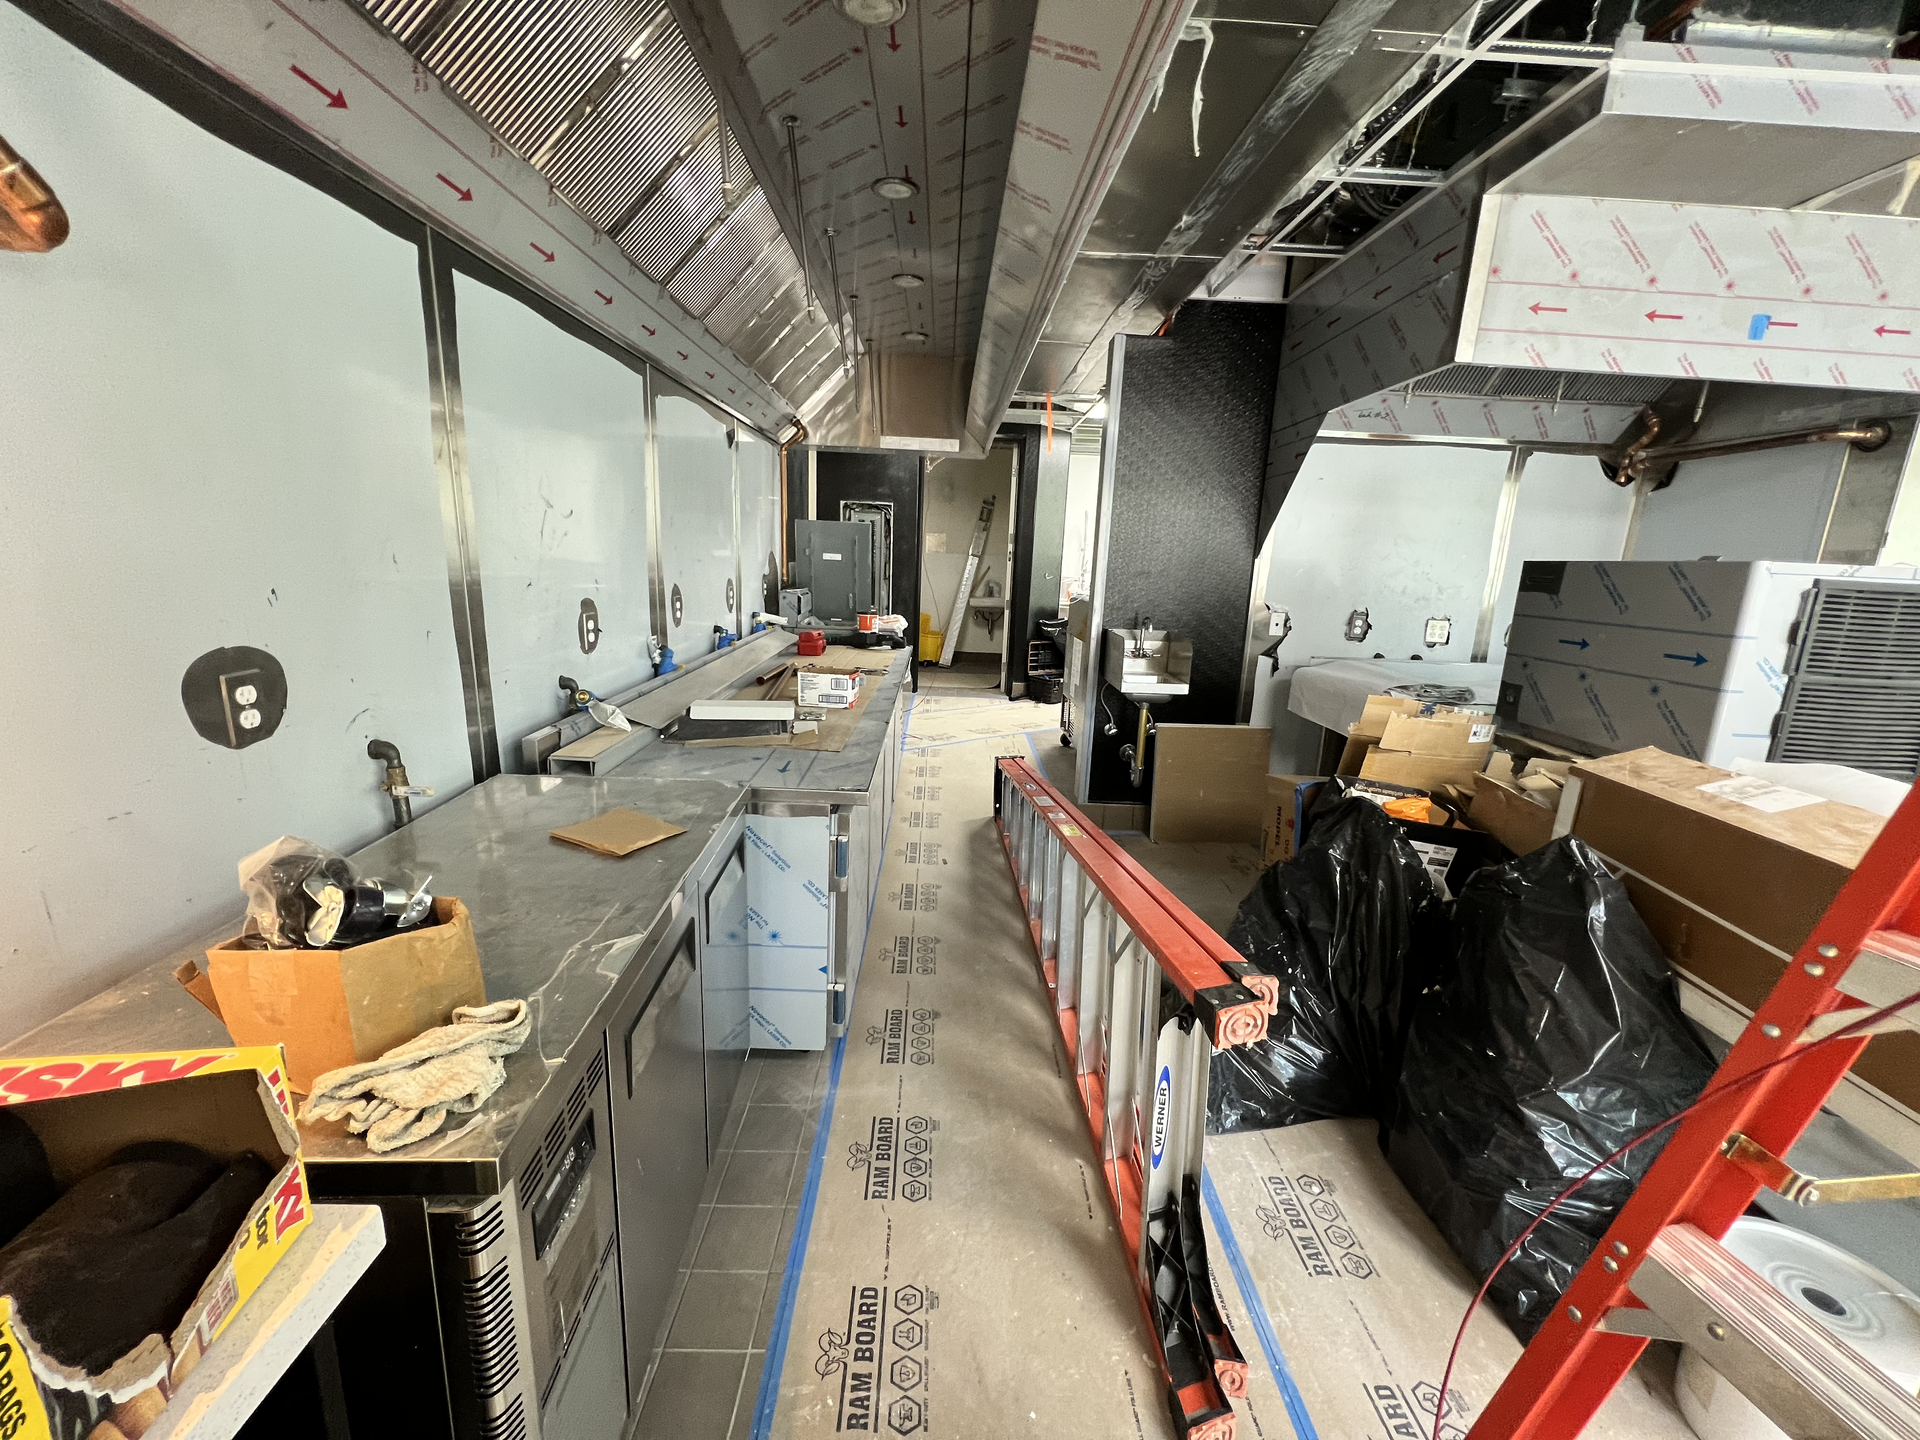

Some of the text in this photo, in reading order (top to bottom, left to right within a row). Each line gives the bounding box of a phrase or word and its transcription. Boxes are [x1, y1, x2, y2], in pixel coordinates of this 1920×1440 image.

[896, 936, 910, 974] RAM BOARD
[886, 1009, 903, 1064] RAM BOARD
[876, 1116, 894, 1162] BOARD
[1154, 1087, 1167, 1148] WERNER
[872, 1166, 890, 1200] RAM
[1268, 1176, 1333, 1276] RAM BOARD
[846, 1286, 878, 1430] RAM BOARD
[1373, 1385, 1419, 1440] ARD
